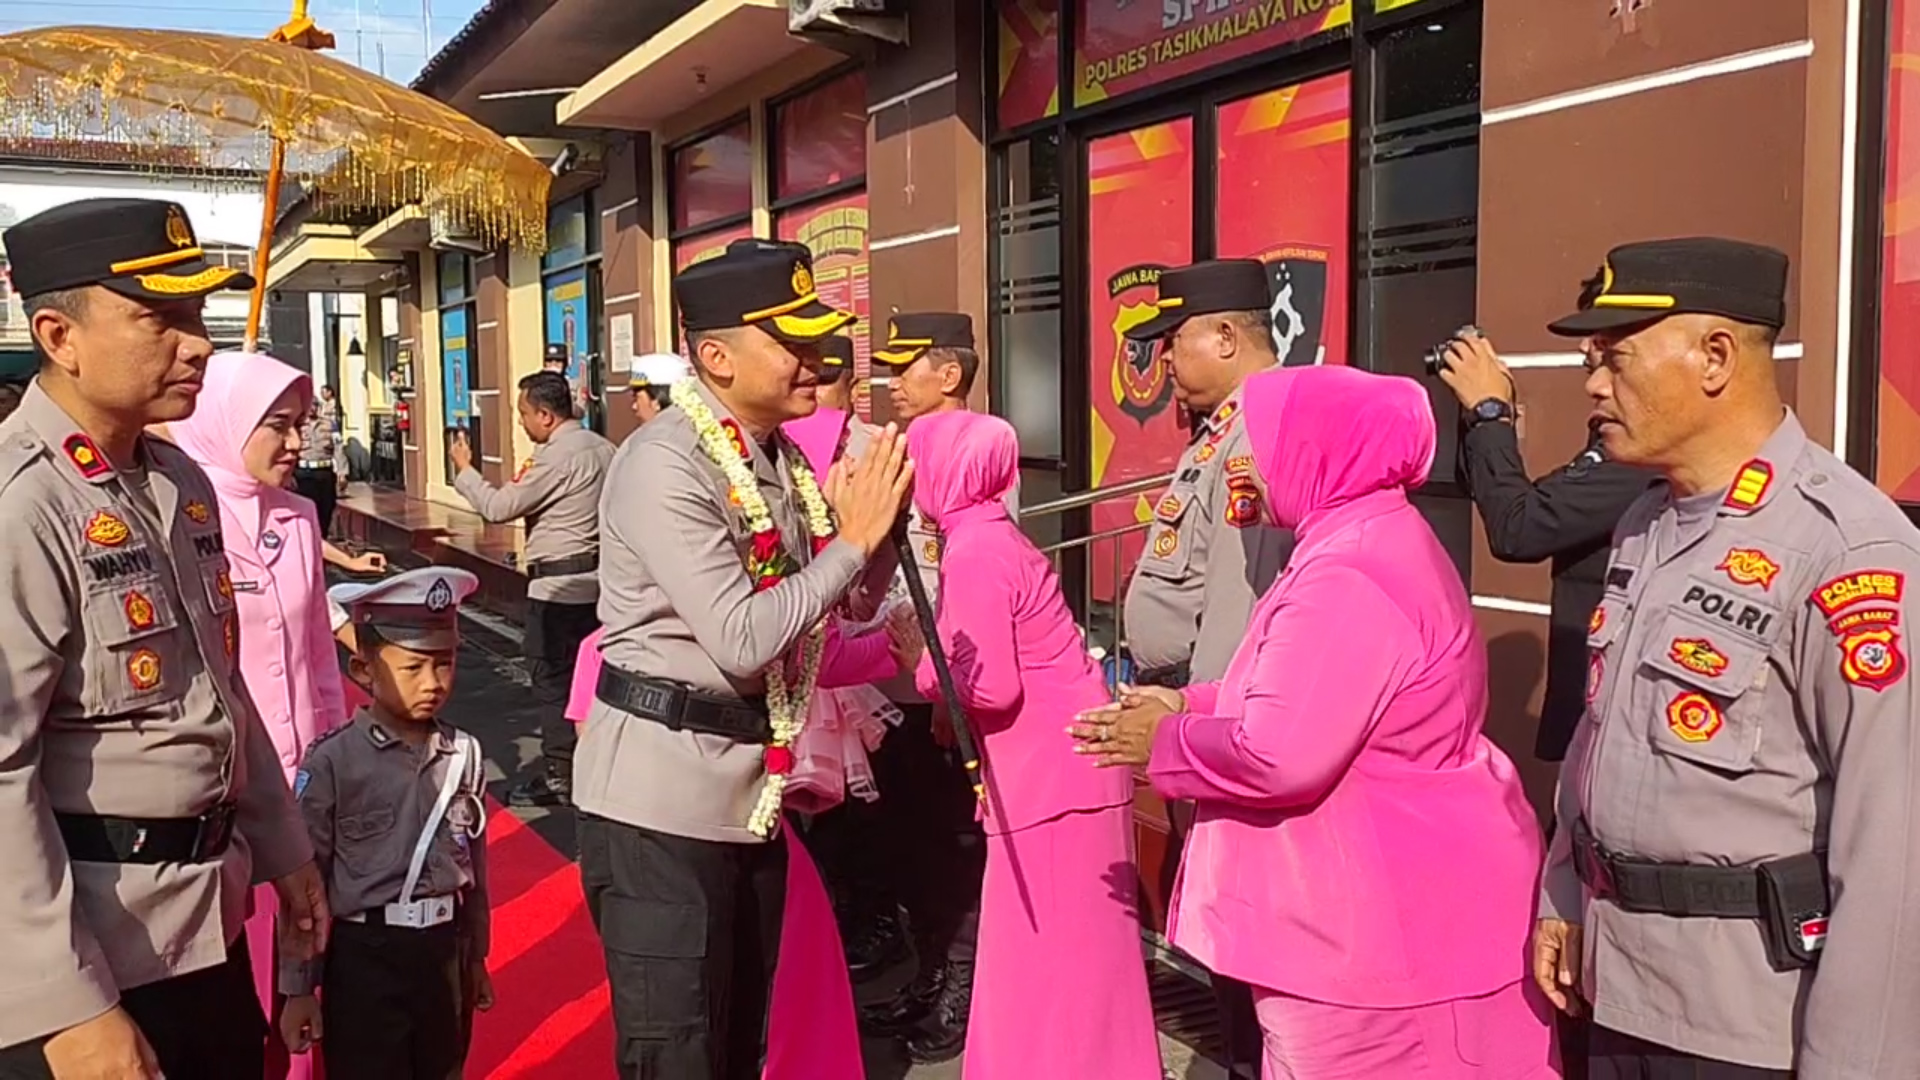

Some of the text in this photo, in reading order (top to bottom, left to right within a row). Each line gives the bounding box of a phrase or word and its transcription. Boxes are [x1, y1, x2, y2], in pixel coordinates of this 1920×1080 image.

[1085, 46, 1147, 87] POLRES
[1152, 0, 1286, 64] TASIKMALAYA
[1112, 269, 1162, 294] JAWA BAR
[89, 547, 152, 580] WAHYU
[1821, 574, 1897, 602] POLRES
[1682, 585, 1773, 635] POLRI
